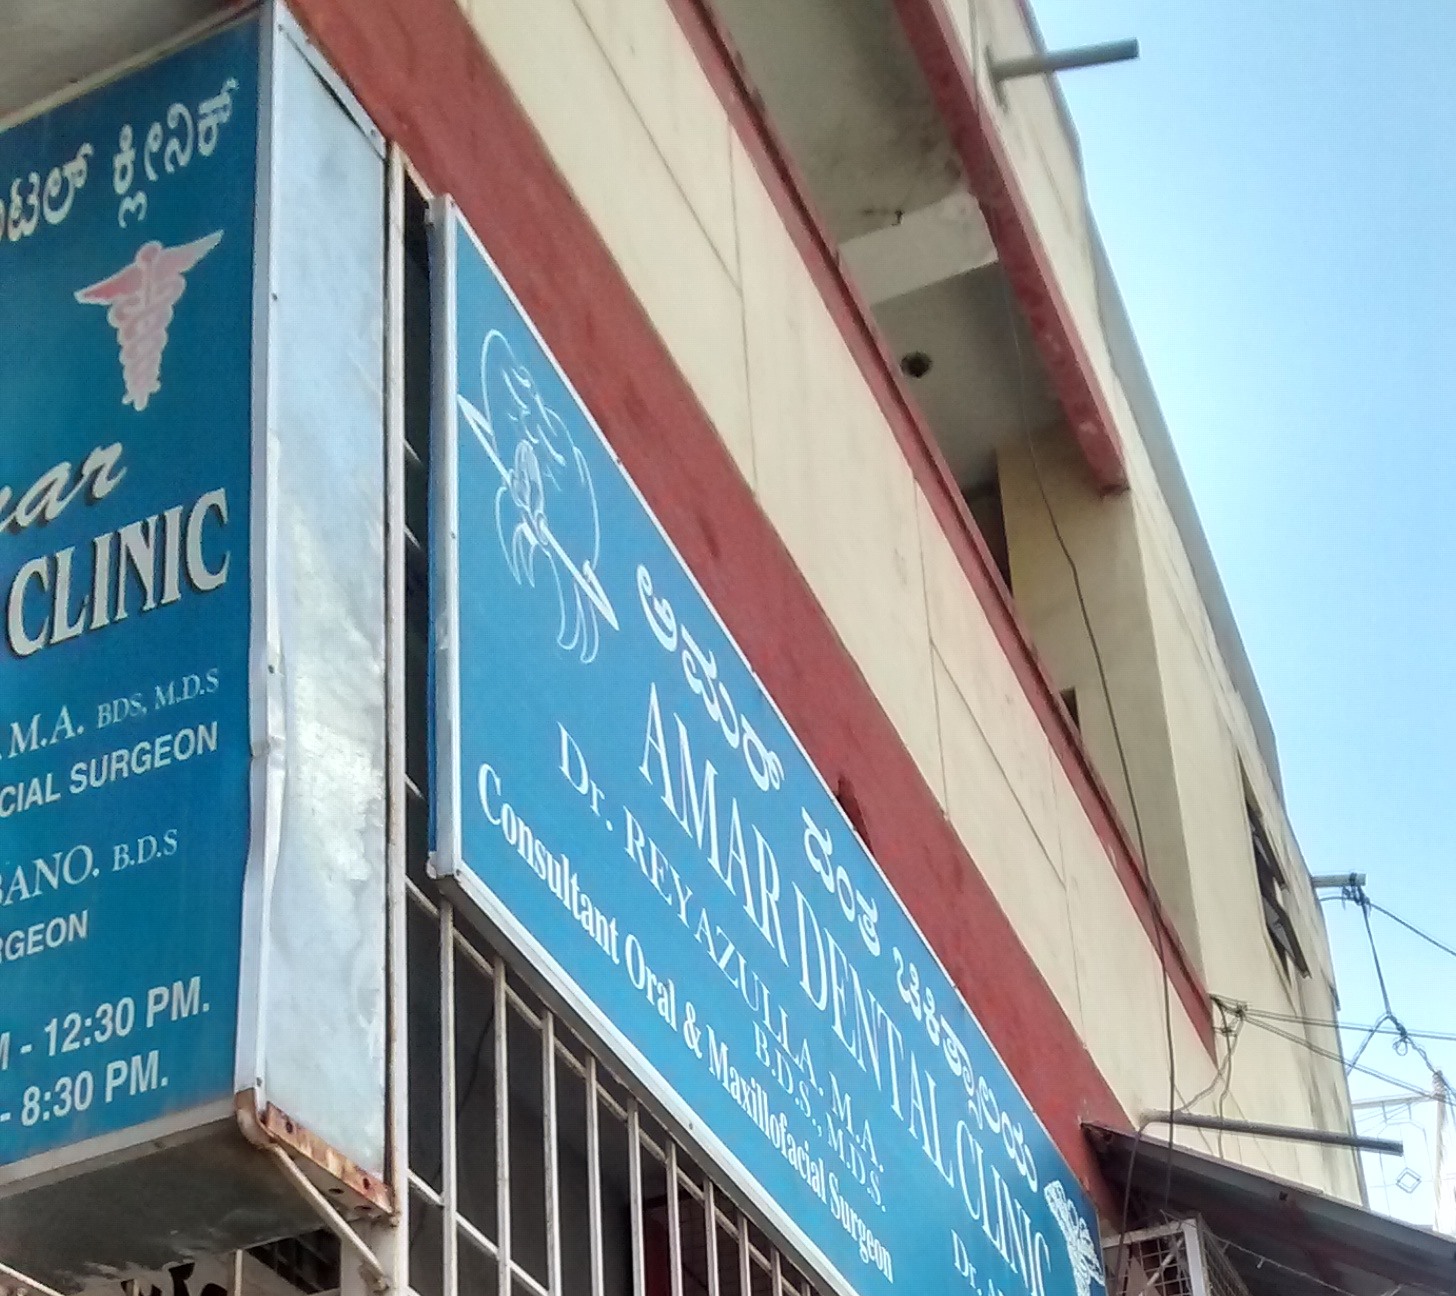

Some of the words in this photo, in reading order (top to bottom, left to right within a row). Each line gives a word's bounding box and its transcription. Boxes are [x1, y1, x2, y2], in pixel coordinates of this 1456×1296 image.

[7, 487, 231, 656] CLINIC
[8, 705, 84, 758] M.A.
[155, 667, 219, 710] M.D.S
[69, 721, 218, 794] SURGEON
[636, 564, 785, 792] ಅಮರ್
[801, 806, 881, 957] ದಂತ
[0, 844, 100, 906] ANO.
[112, 829, 179, 874] B.D.S
[0, 909, 88, 962] GEON
[557, 722, 613, 832] Dr.
[829, 1071, 884, 1172] M.A.
[639, 682, 789, 967] AMAR
[792, 880, 954, 1188] DENTAL
[44, 997, 135, 1056] 12:30
[146, 976, 210, 1028] PM.
[478, 763, 620, 964] Consultant
[625, 934, 677, 1031] Oral
[683, 1001, 703, 1058] &
[706, 1024, 826, 1204] Maxillofacial
[829, 1171, 893, 1283] Surgeon
[21, 1071, 93, 1127] 8:30
[105, 1050, 168, 1104] PM.
[825, 1112, 886, 1212] M.D.S.
[951, 1230, 983, 1296] Dr.
